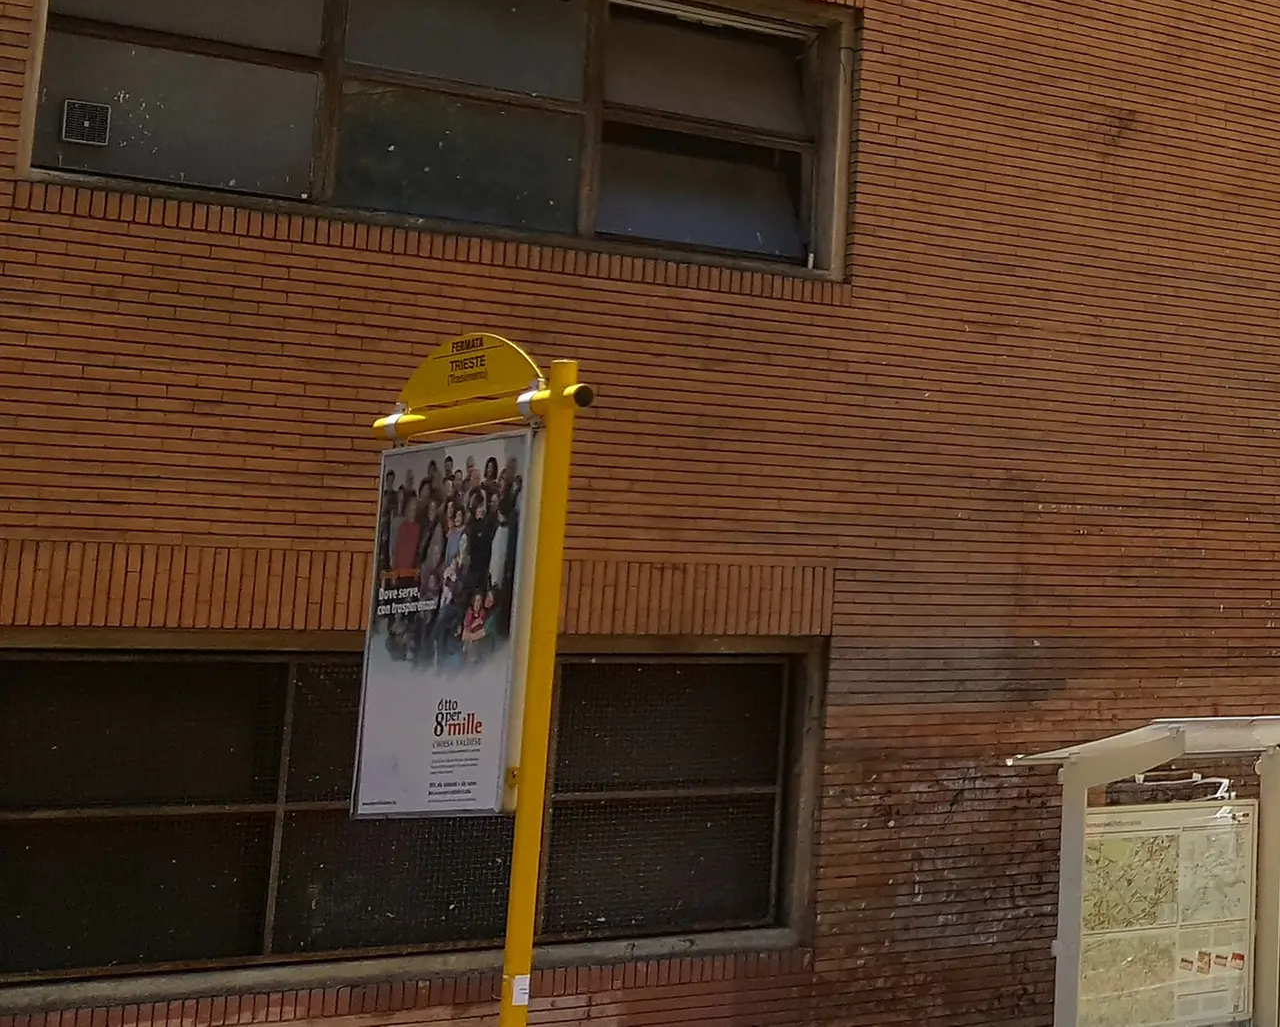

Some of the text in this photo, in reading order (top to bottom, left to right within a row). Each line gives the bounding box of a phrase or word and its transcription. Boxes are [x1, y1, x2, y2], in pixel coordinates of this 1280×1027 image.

[451, 336, 484, 353] FERMATA
[449, 354, 486, 372] TRIESTE
[378, 587, 398, 600] Dove
[433, 711, 483, 737] 8 per mille
